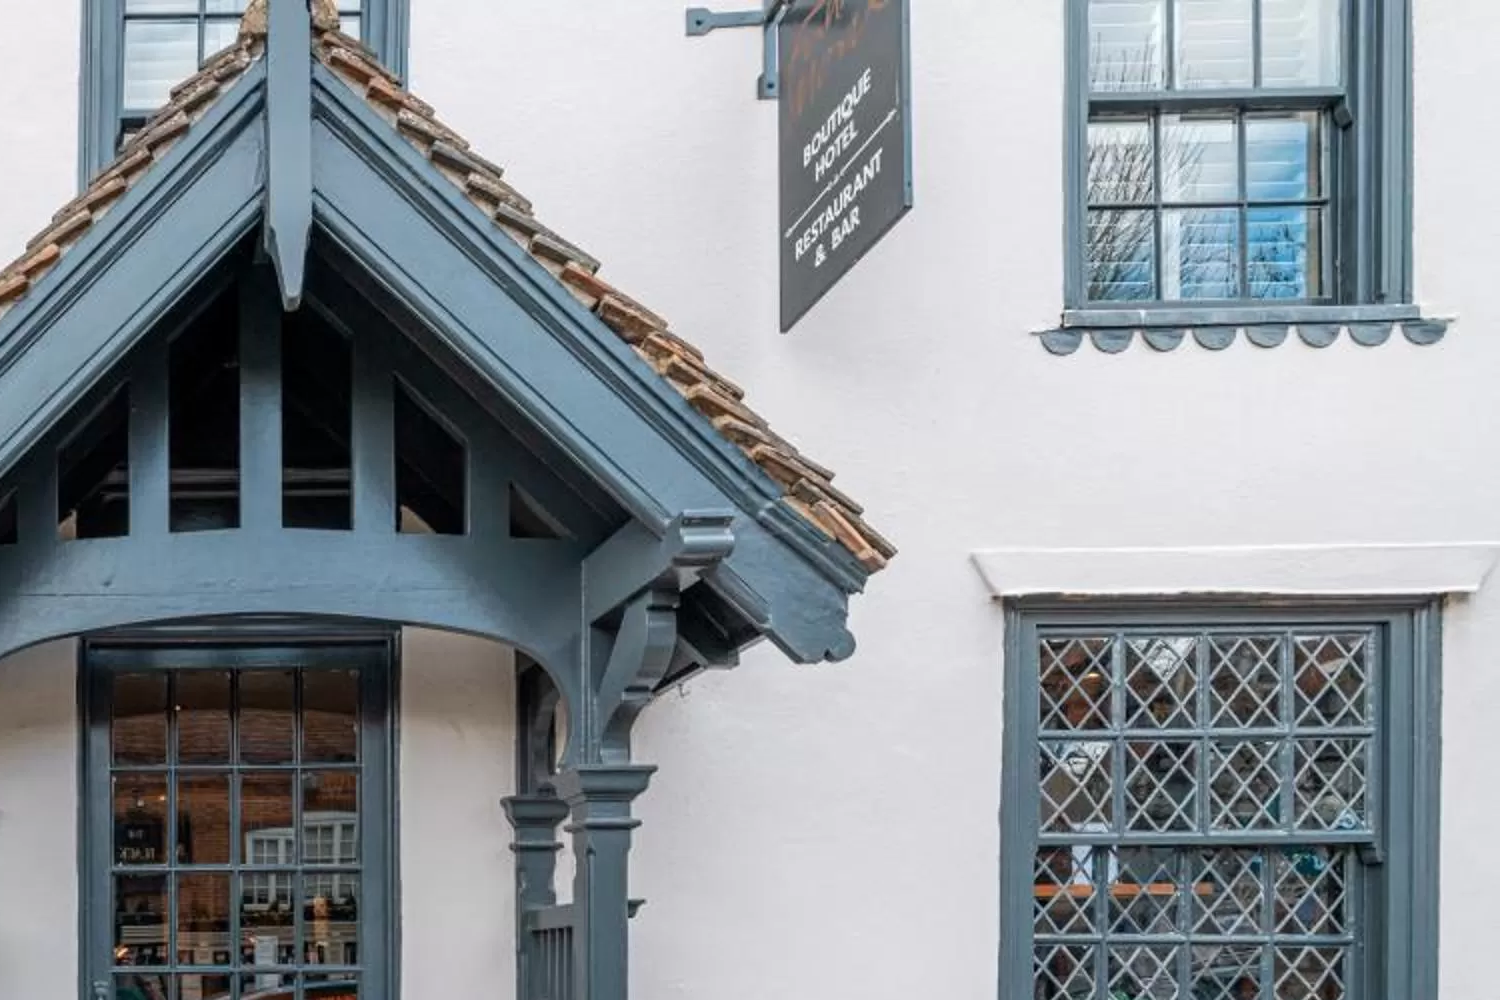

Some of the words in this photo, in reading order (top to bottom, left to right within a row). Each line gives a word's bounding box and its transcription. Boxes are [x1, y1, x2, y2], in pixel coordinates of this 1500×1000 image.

[803, 67, 872, 168] BOUTIQUE
[815, 120, 858, 182] HOTEL
[795, 148, 883, 262] RESTAURANT
[814, 243, 827, 268] &
[831, 206, 861, 251] BAR
